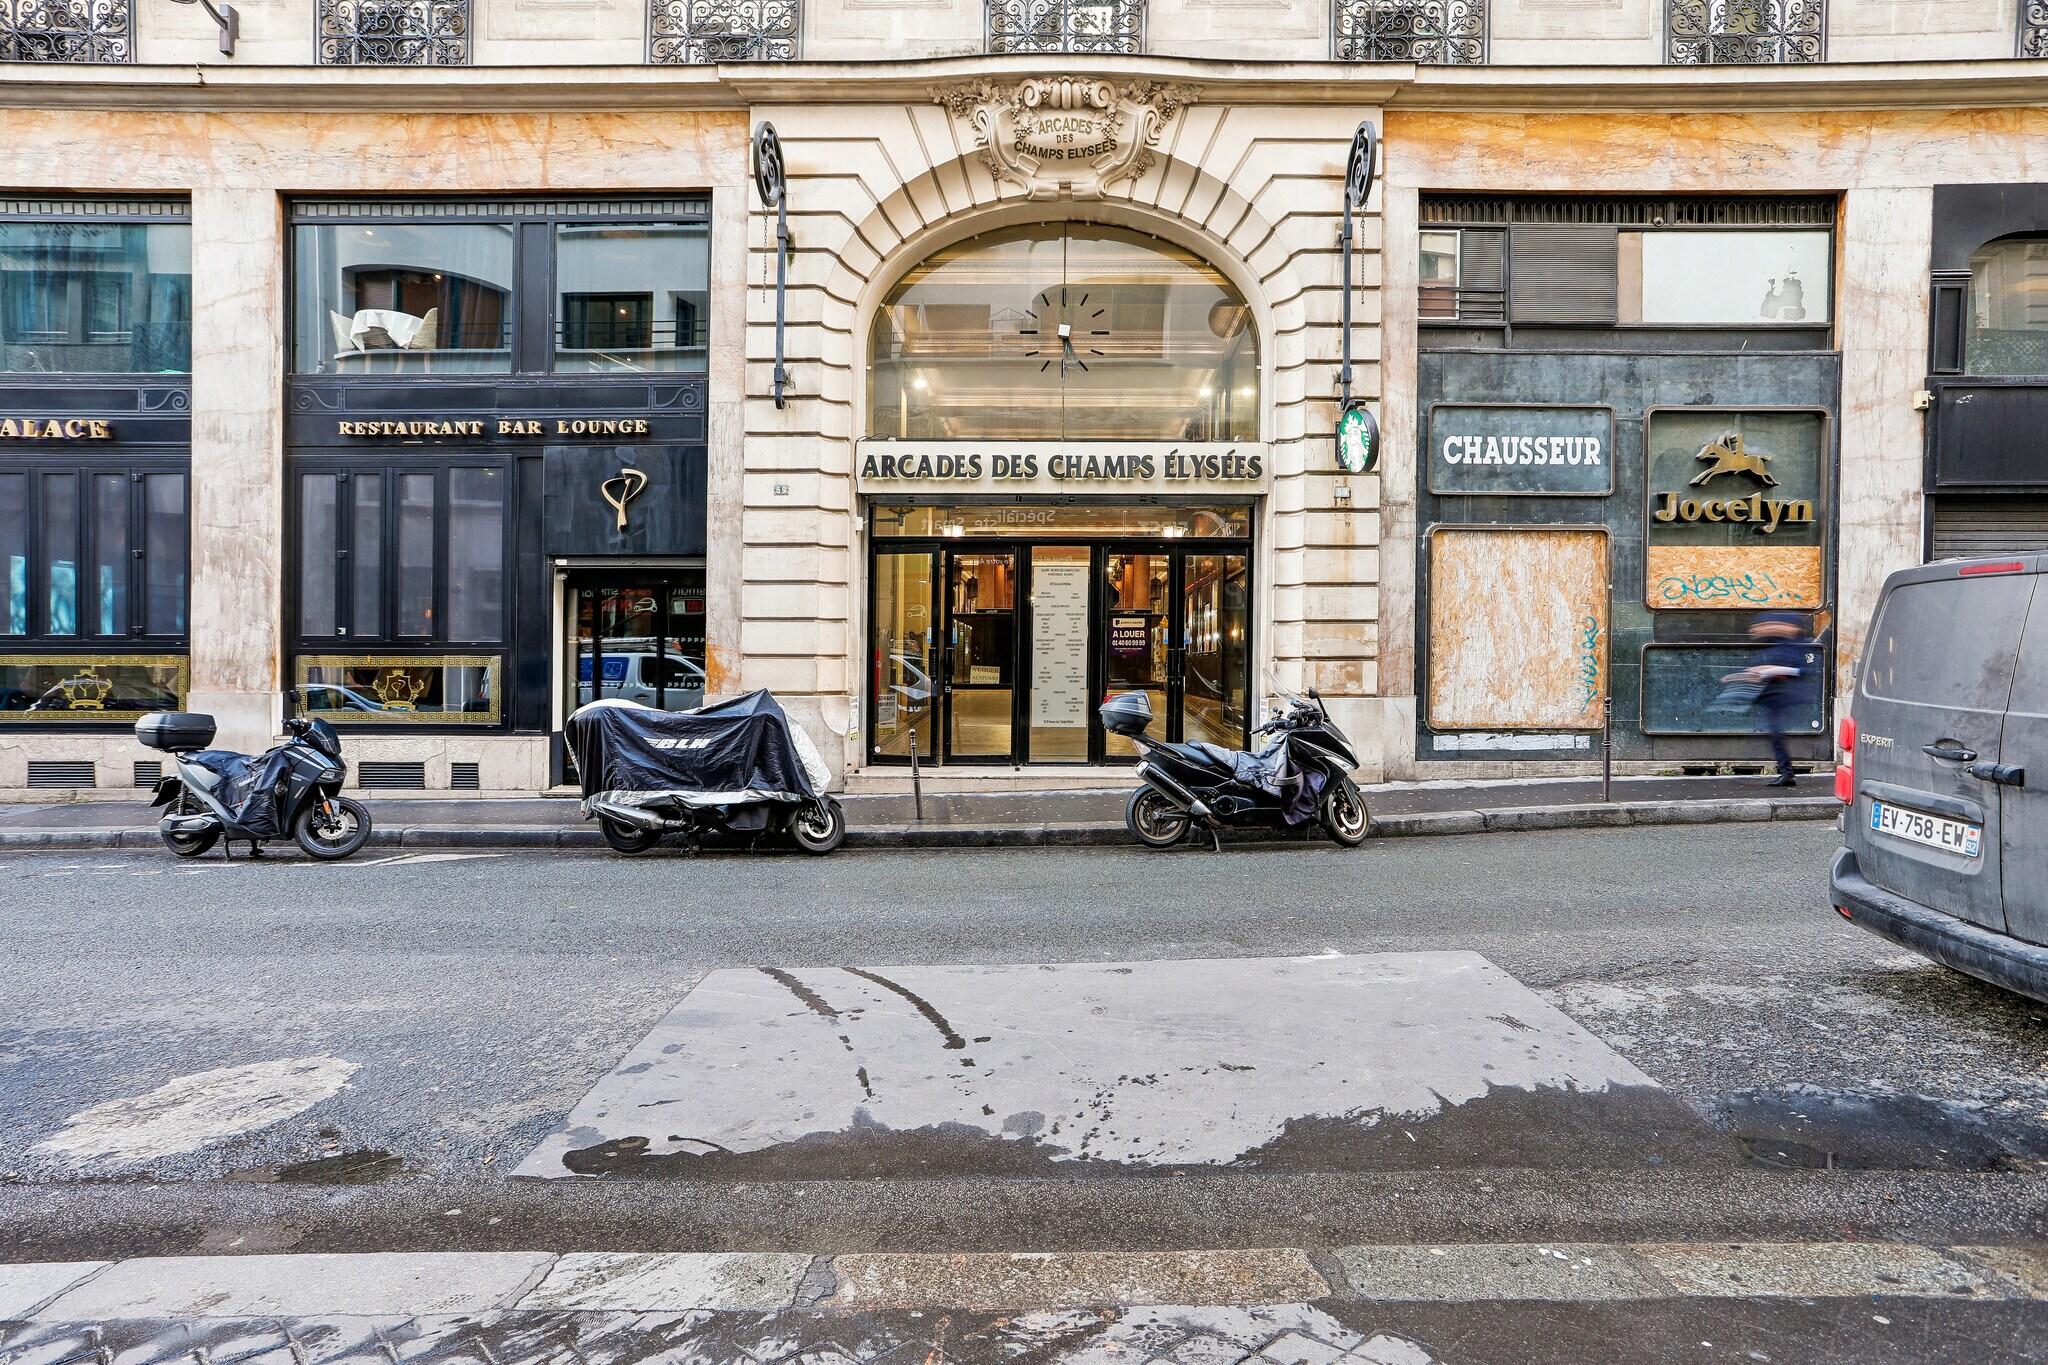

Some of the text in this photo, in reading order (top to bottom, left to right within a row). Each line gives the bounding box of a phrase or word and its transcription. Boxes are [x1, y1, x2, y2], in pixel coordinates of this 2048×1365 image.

[1038, 117, 1093, 135] ARCADES
[1056, 134, 1074, 144] DES
[1014, 138, 1118, 160] CHAMPS ELYSEES
[338, 419, 649, 436] RESTAURANT BAR LOUNGE
[1443, 436, 1601, 465] CHAUSSEUR
[861, 448, 1264, 480] ARCADES DES CHAMPS ÉLYSÉES
[1654, 491, 1816, 534] Jocelyn
[1112, 630, 1145, 638] A LOUER
[655, 738, 712, 749] BLH
[1860, 733, 1894, 748] EXPERT
[1881, 807, 1965, 848] EV-758-EW
[1965, 841, 1977, 853] 92
